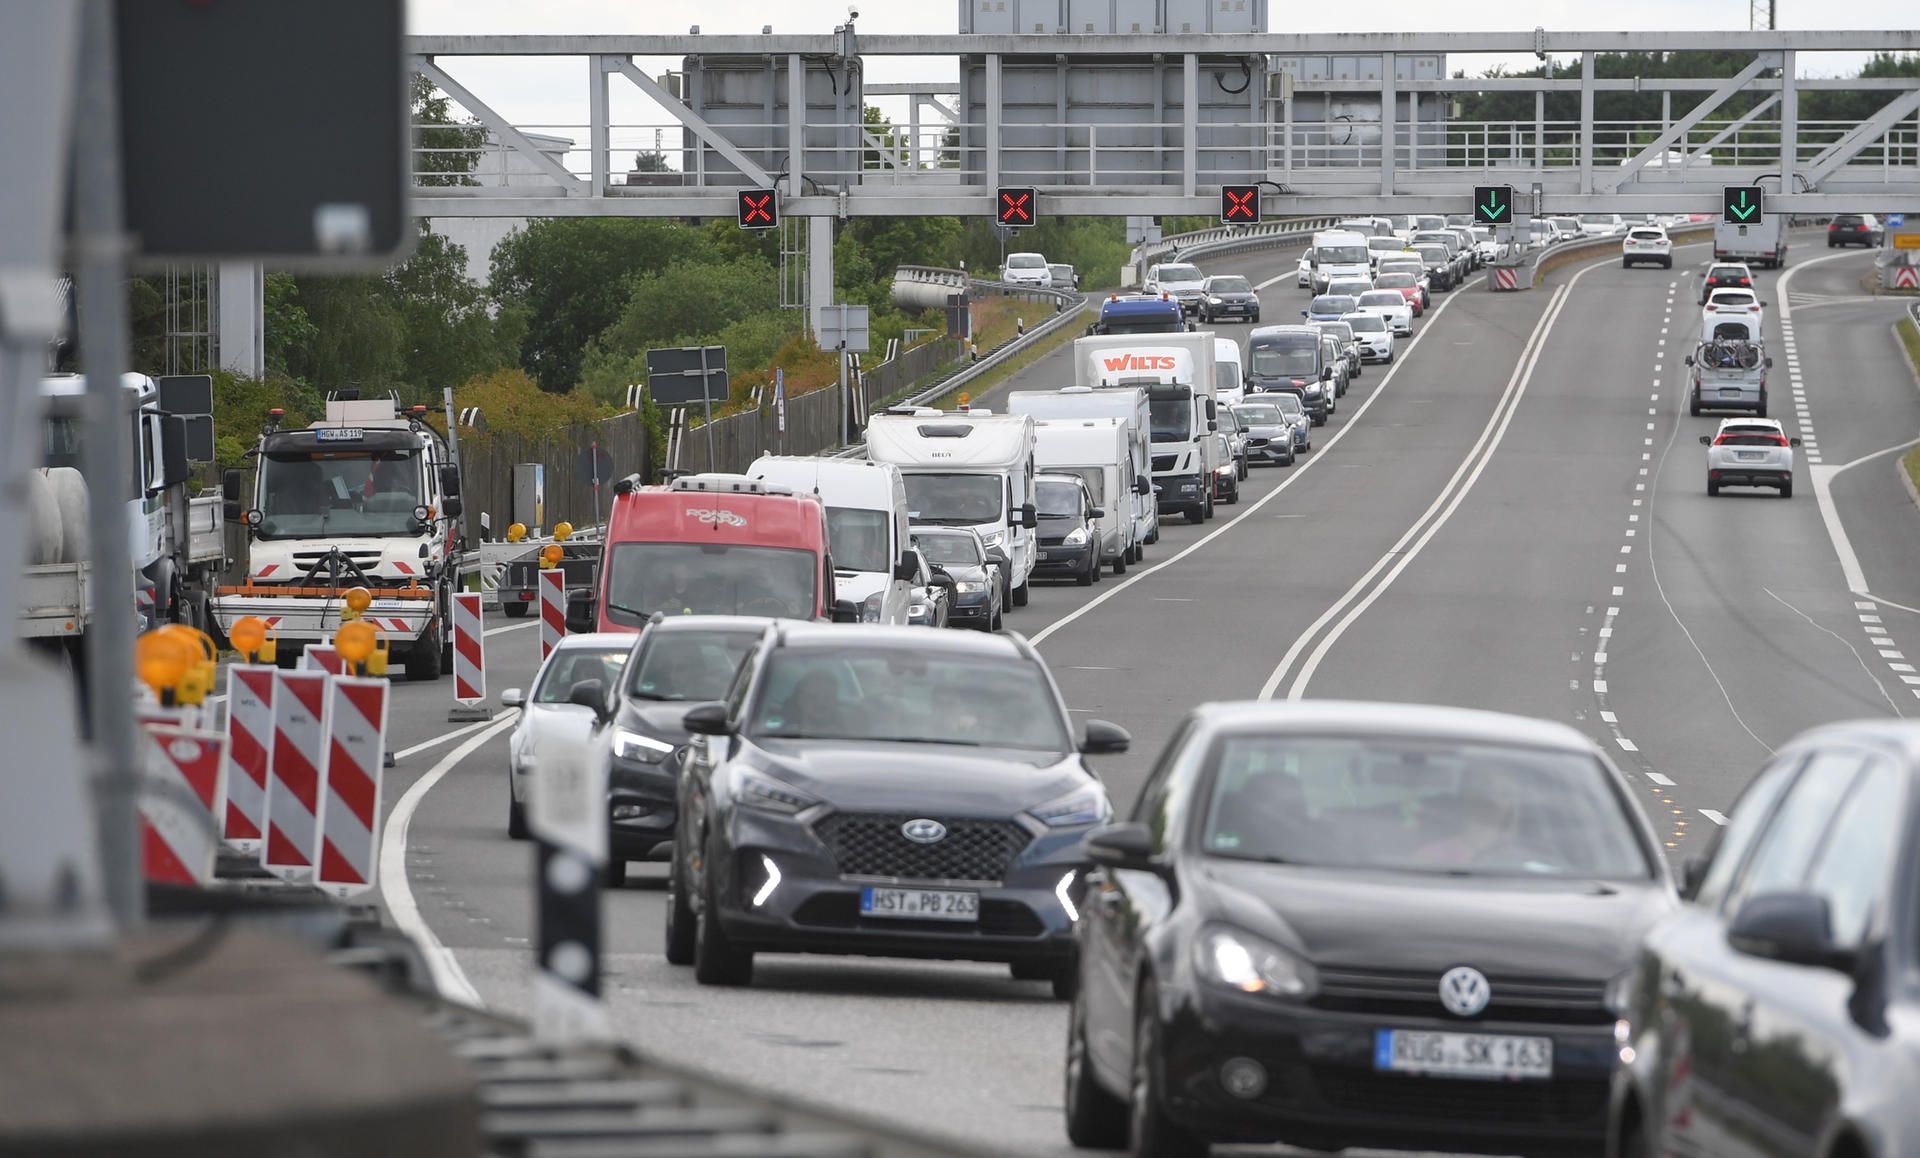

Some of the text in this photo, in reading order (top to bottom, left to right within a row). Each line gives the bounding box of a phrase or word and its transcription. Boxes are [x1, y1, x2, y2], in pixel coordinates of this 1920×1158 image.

[1103, 353, 1176, 372] WILTS
[350, 429, 362, 438] 119
[875, 890, 977, 913] HST PB 263
[1464, 1037, 1494, 1064] SK
[1502, 1040, 1548, 1067] 163
